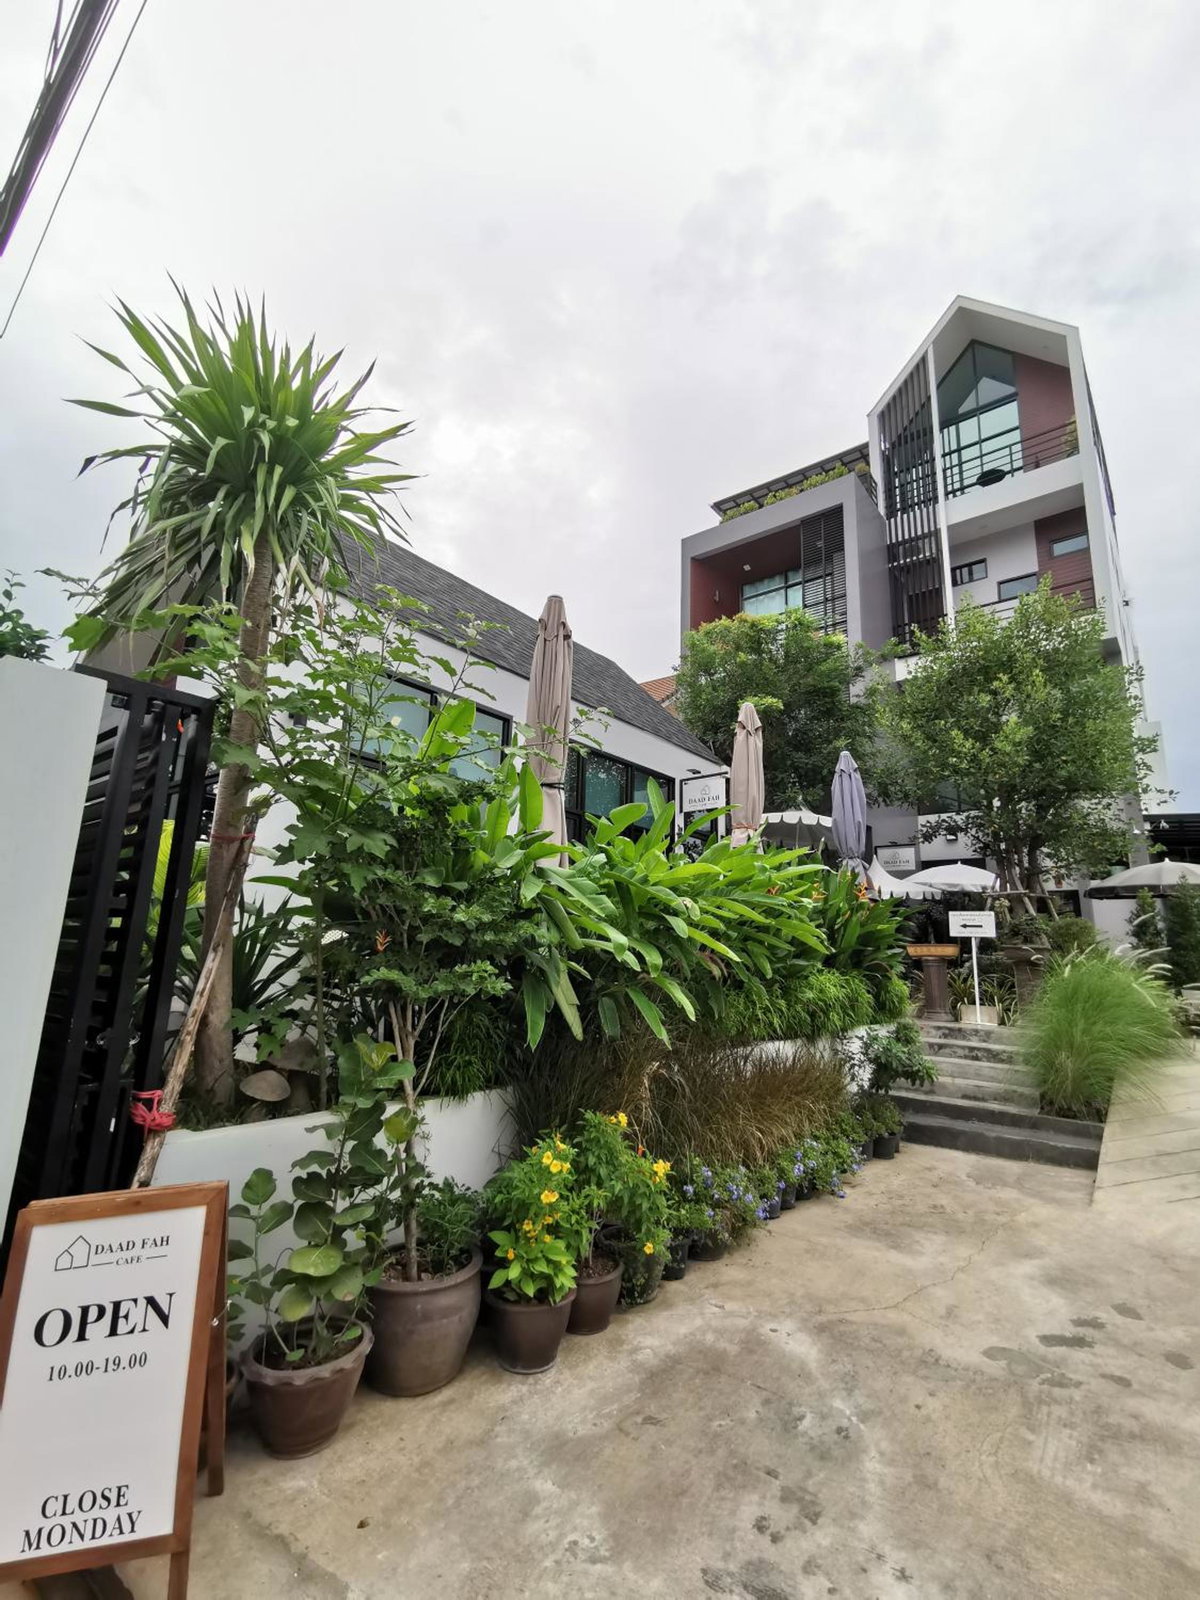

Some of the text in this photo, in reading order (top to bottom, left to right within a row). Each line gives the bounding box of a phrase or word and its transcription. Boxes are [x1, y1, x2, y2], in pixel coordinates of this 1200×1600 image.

[94, 1235, 171, 1255] DAAD FAH
[115, 1255, 143, 1266] CAFE
[33, 1292, 176, 1348] OPEN
[47, 1352, 148, 1381] 10.00-19.00
[40, 1484, 130, 1520] CLOSE
[20, 1510, 143, 1553] MONDAY
